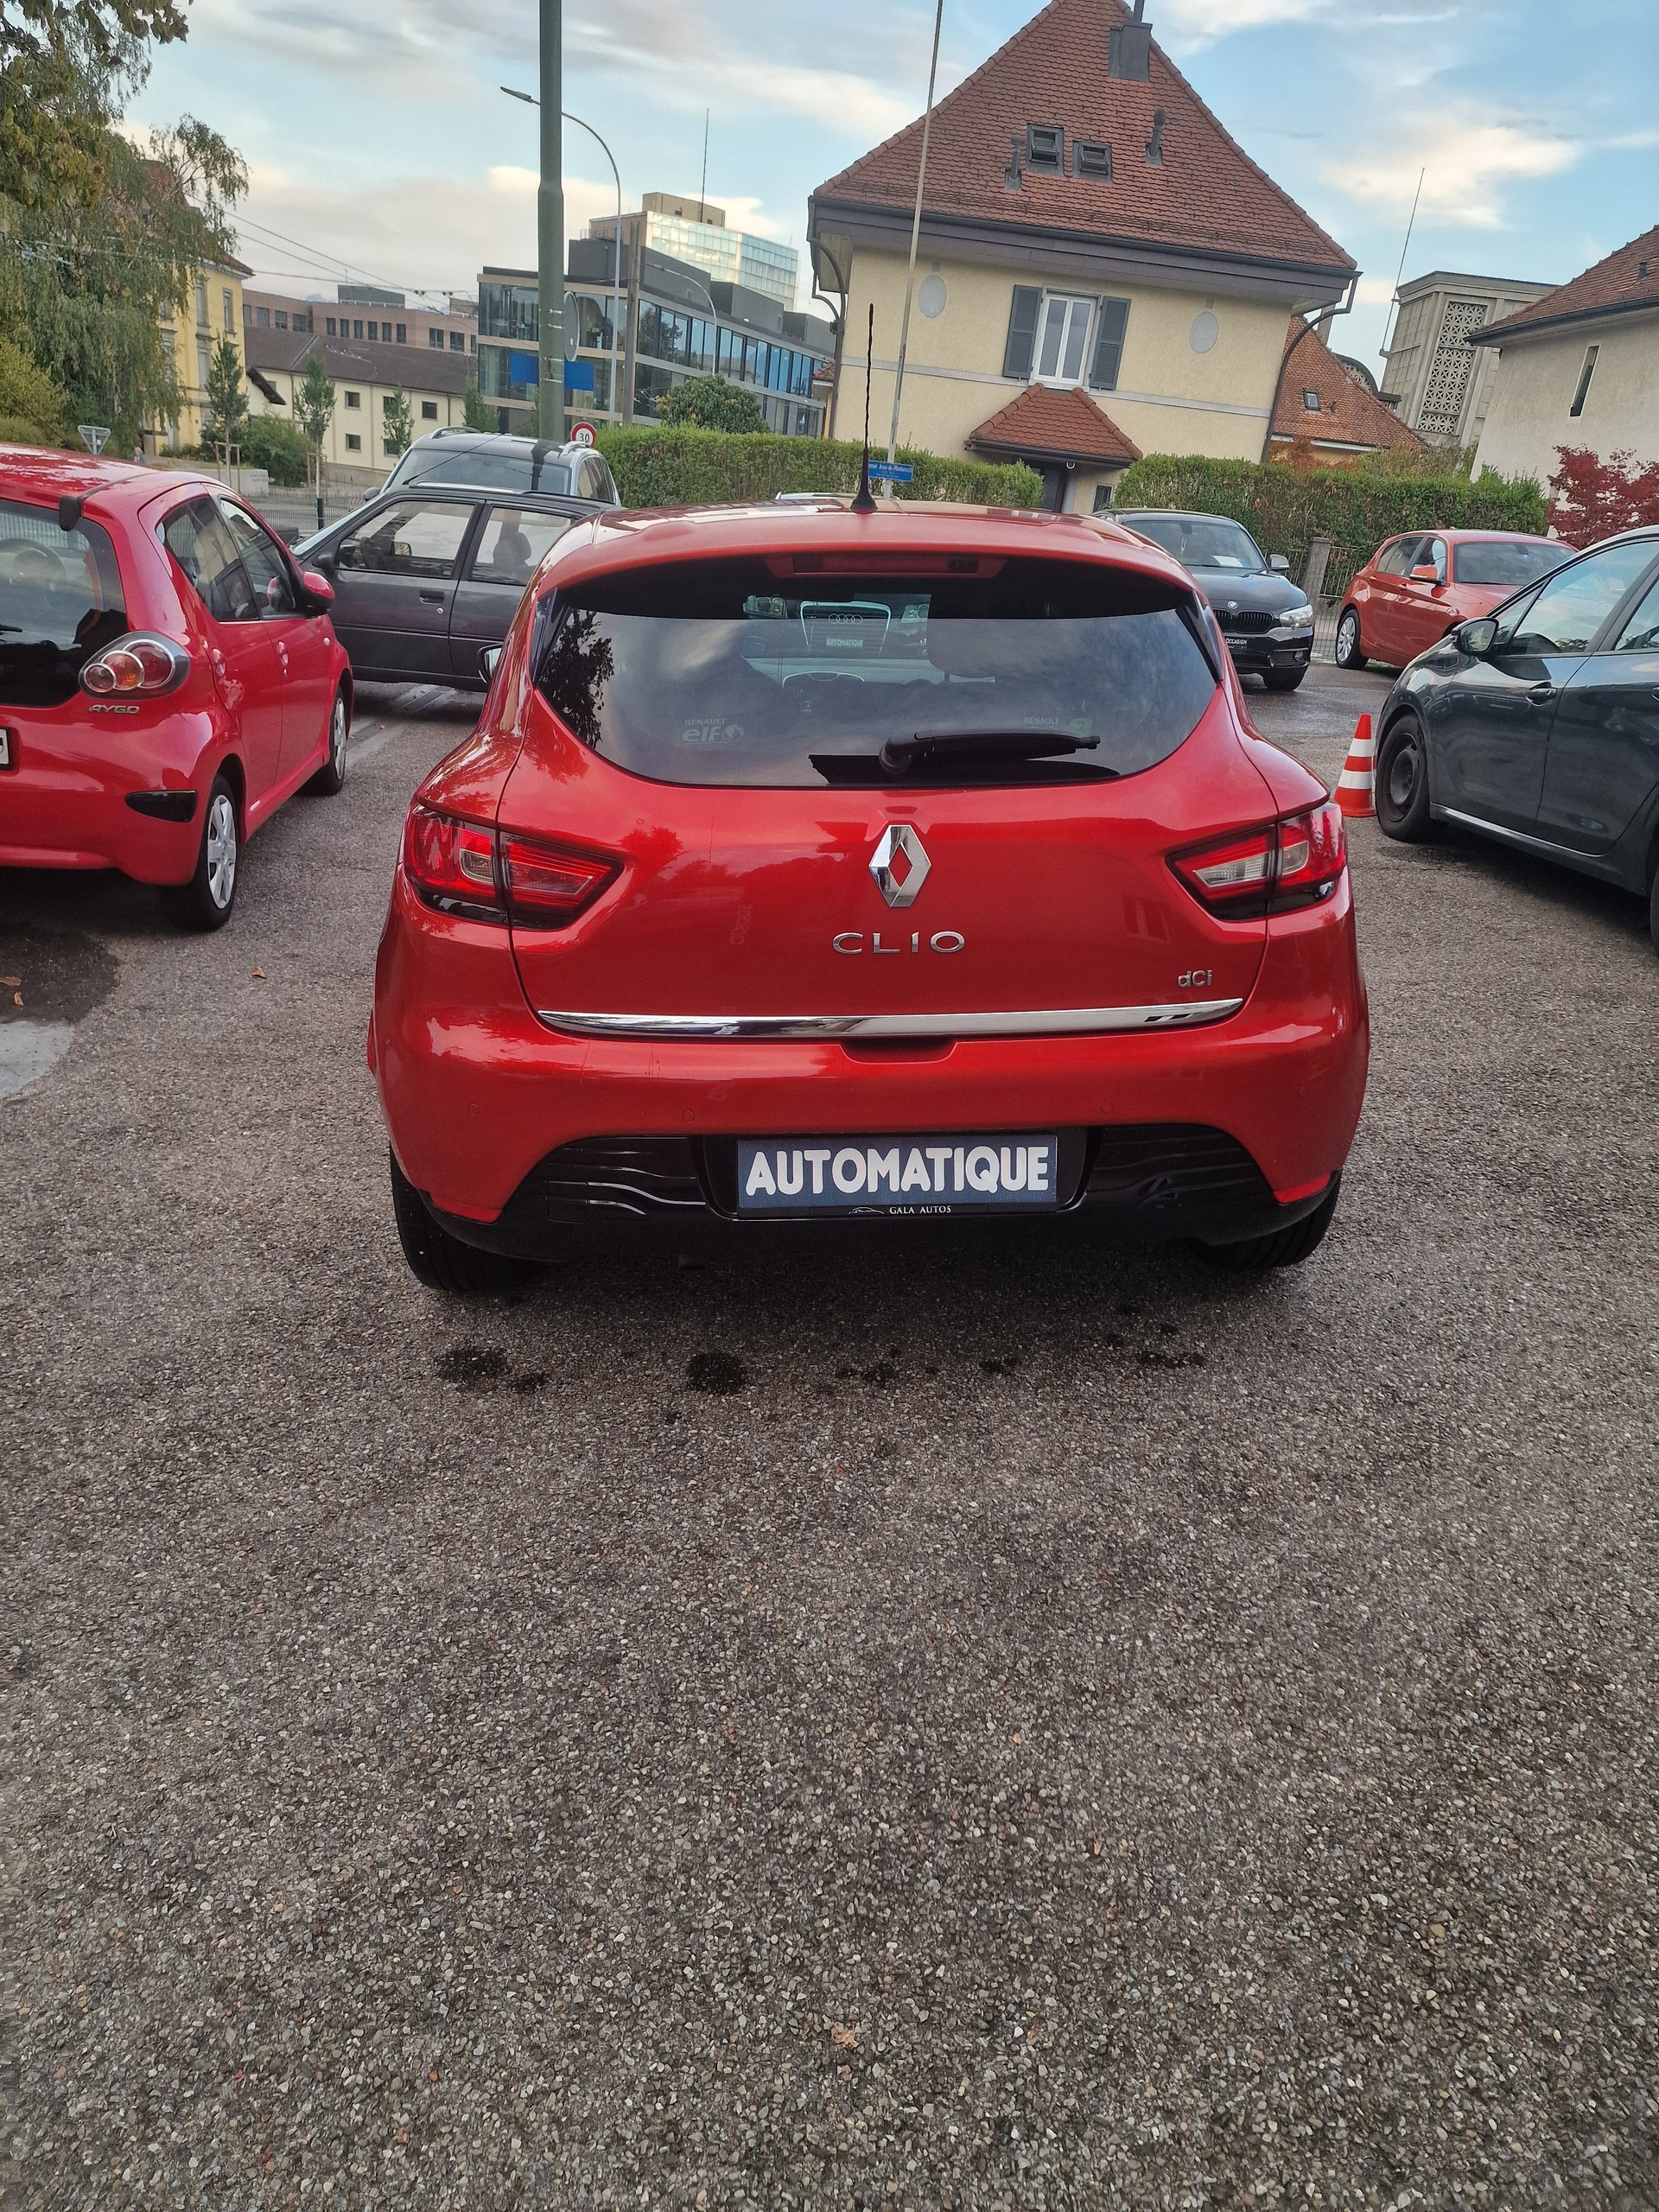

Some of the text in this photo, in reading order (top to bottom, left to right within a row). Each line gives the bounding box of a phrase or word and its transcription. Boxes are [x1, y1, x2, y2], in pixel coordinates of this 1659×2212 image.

[579, 432, 590, 443] 30
[826, 638, 864, 648] AUTOMATIQUE
[88, 704, 140, 715] AYGO
[684, 717, 727, 726] RENAULT
[832, 931, 965, 955] CLIO
[1178, 969, 1213, 988] dCi
[745, 1146, 1050, 1197] AUTOMATIQUE
[889, 1205, 951, 1215] GALA AUTOS
